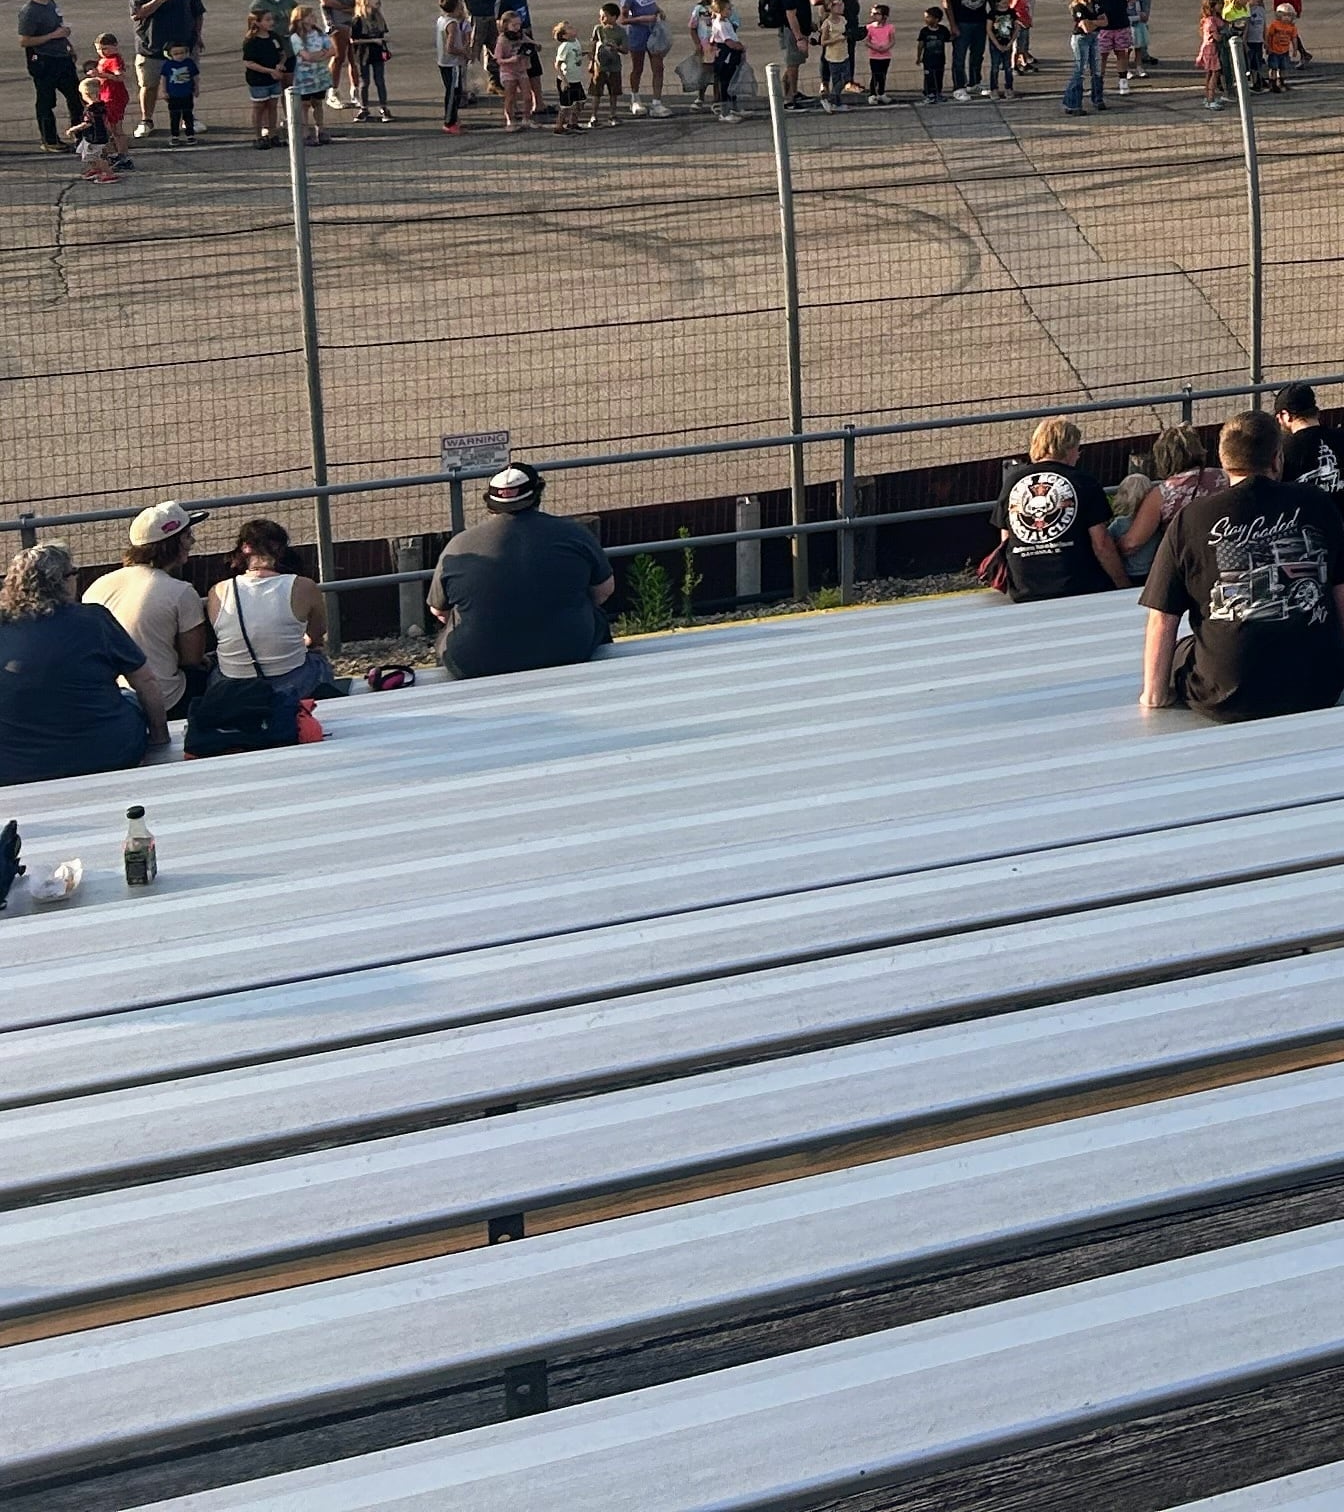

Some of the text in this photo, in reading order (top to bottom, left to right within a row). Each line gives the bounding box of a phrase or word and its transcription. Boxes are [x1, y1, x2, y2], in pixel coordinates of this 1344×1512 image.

[446, 434, 506, 448] WARNING
[1207, 506, 1301, 549] Stay Loaded
